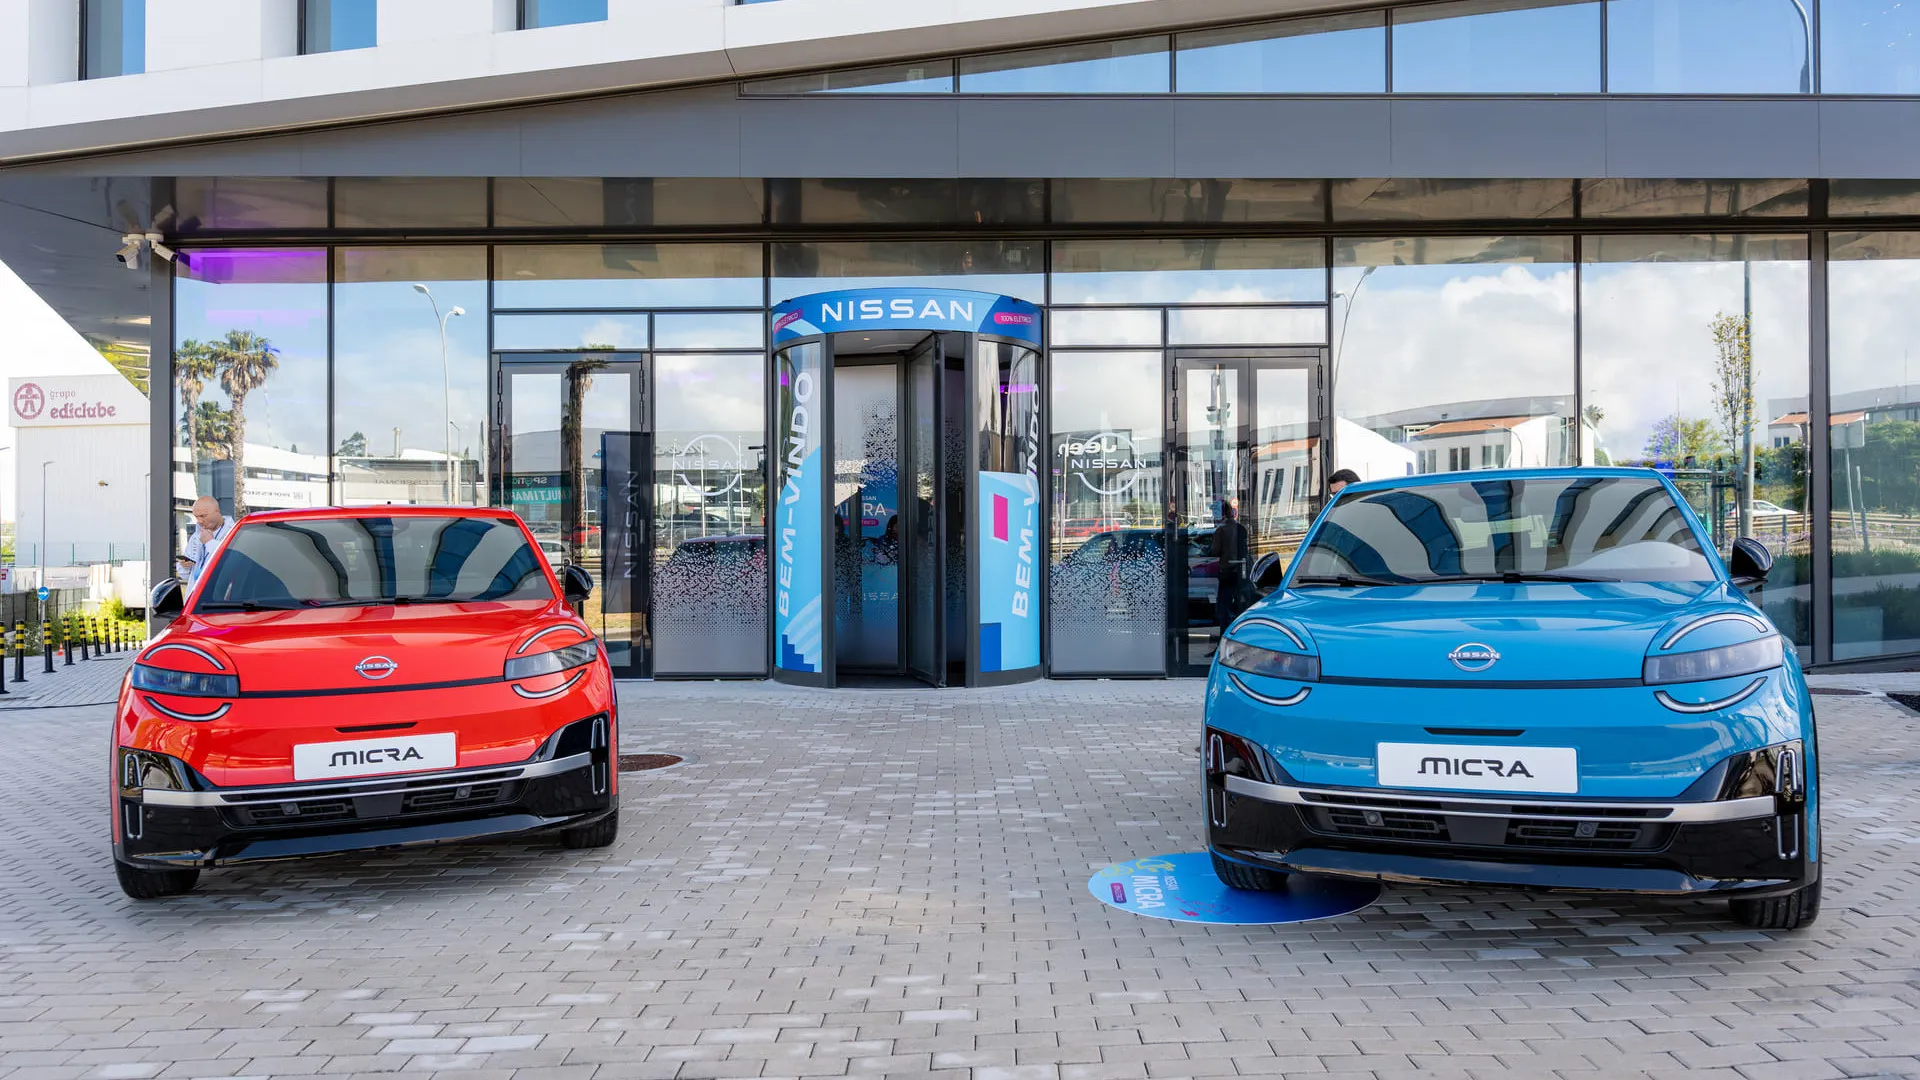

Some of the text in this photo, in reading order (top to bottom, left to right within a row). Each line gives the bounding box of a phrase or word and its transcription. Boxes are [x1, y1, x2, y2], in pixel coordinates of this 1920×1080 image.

[821, 299, 973, 323] NISSAN
[50, 389, 76, 400] grupo
[50, 401, 117, 419] ediclube
[673, 460, 748, 470] NISSAN
[1071, 459, 1147, 469] NISSAN
[778, 372, 814, 618] BEM-VINDO
[1011, 383, 1040, 618] BEM-VINDO
[623, 471, 639, 578] NISSAN
[354, 662, 398, 671] NISSAN
[1448, 652, 1500, 660] NISSAN
[328, 746, 424, 767] MICRA
[1417, 757, 1534, 778] MICRA
[1131, 875, 1166, 909] MICRA
